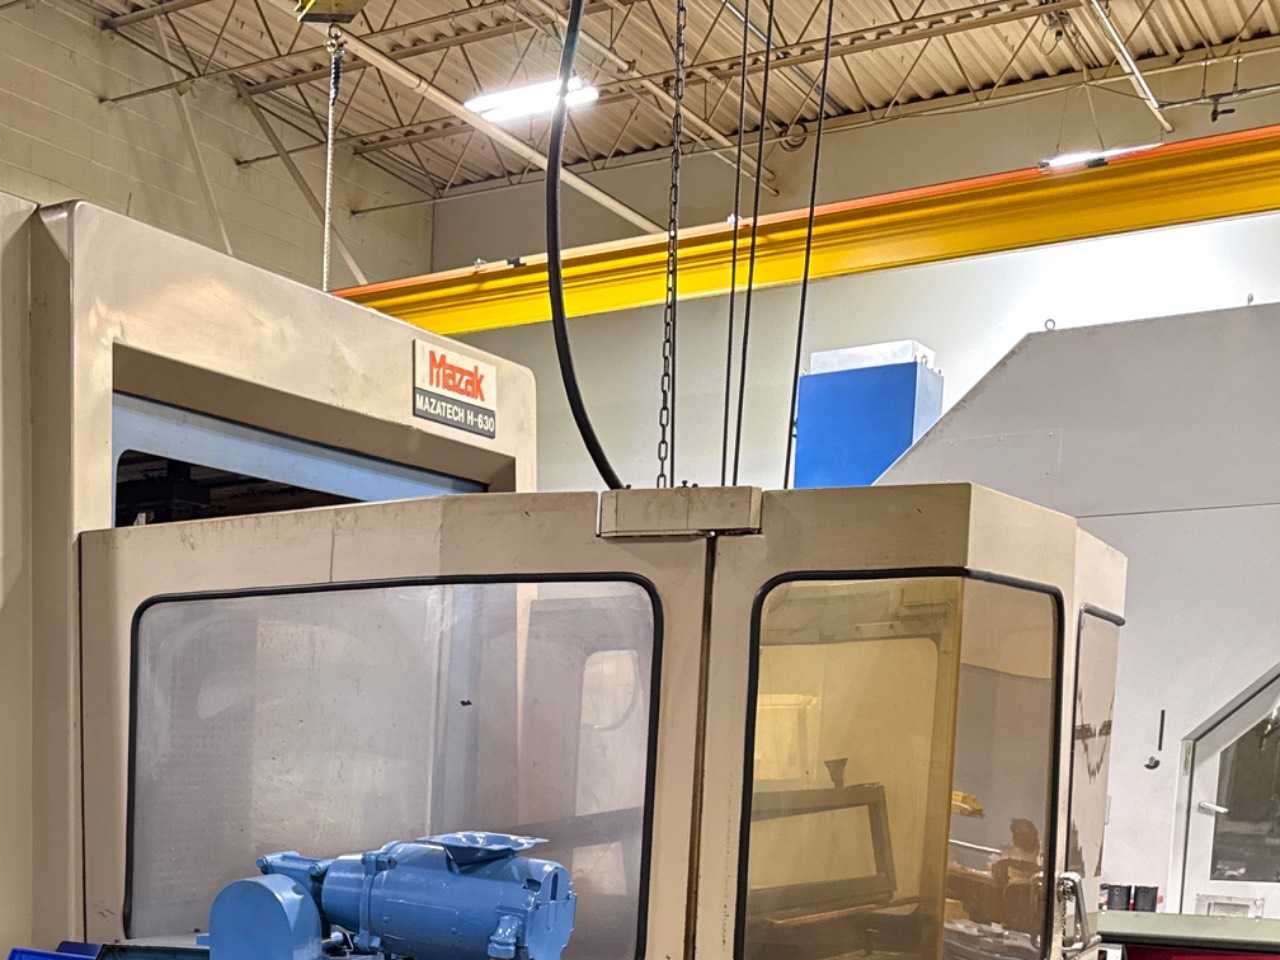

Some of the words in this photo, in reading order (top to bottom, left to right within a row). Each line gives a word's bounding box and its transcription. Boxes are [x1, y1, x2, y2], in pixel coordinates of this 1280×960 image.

[429, 350, 485, 402] Mazak
[416, 393, 465, 420] MAZATECH
[466, 409, 495, 432] H-630
